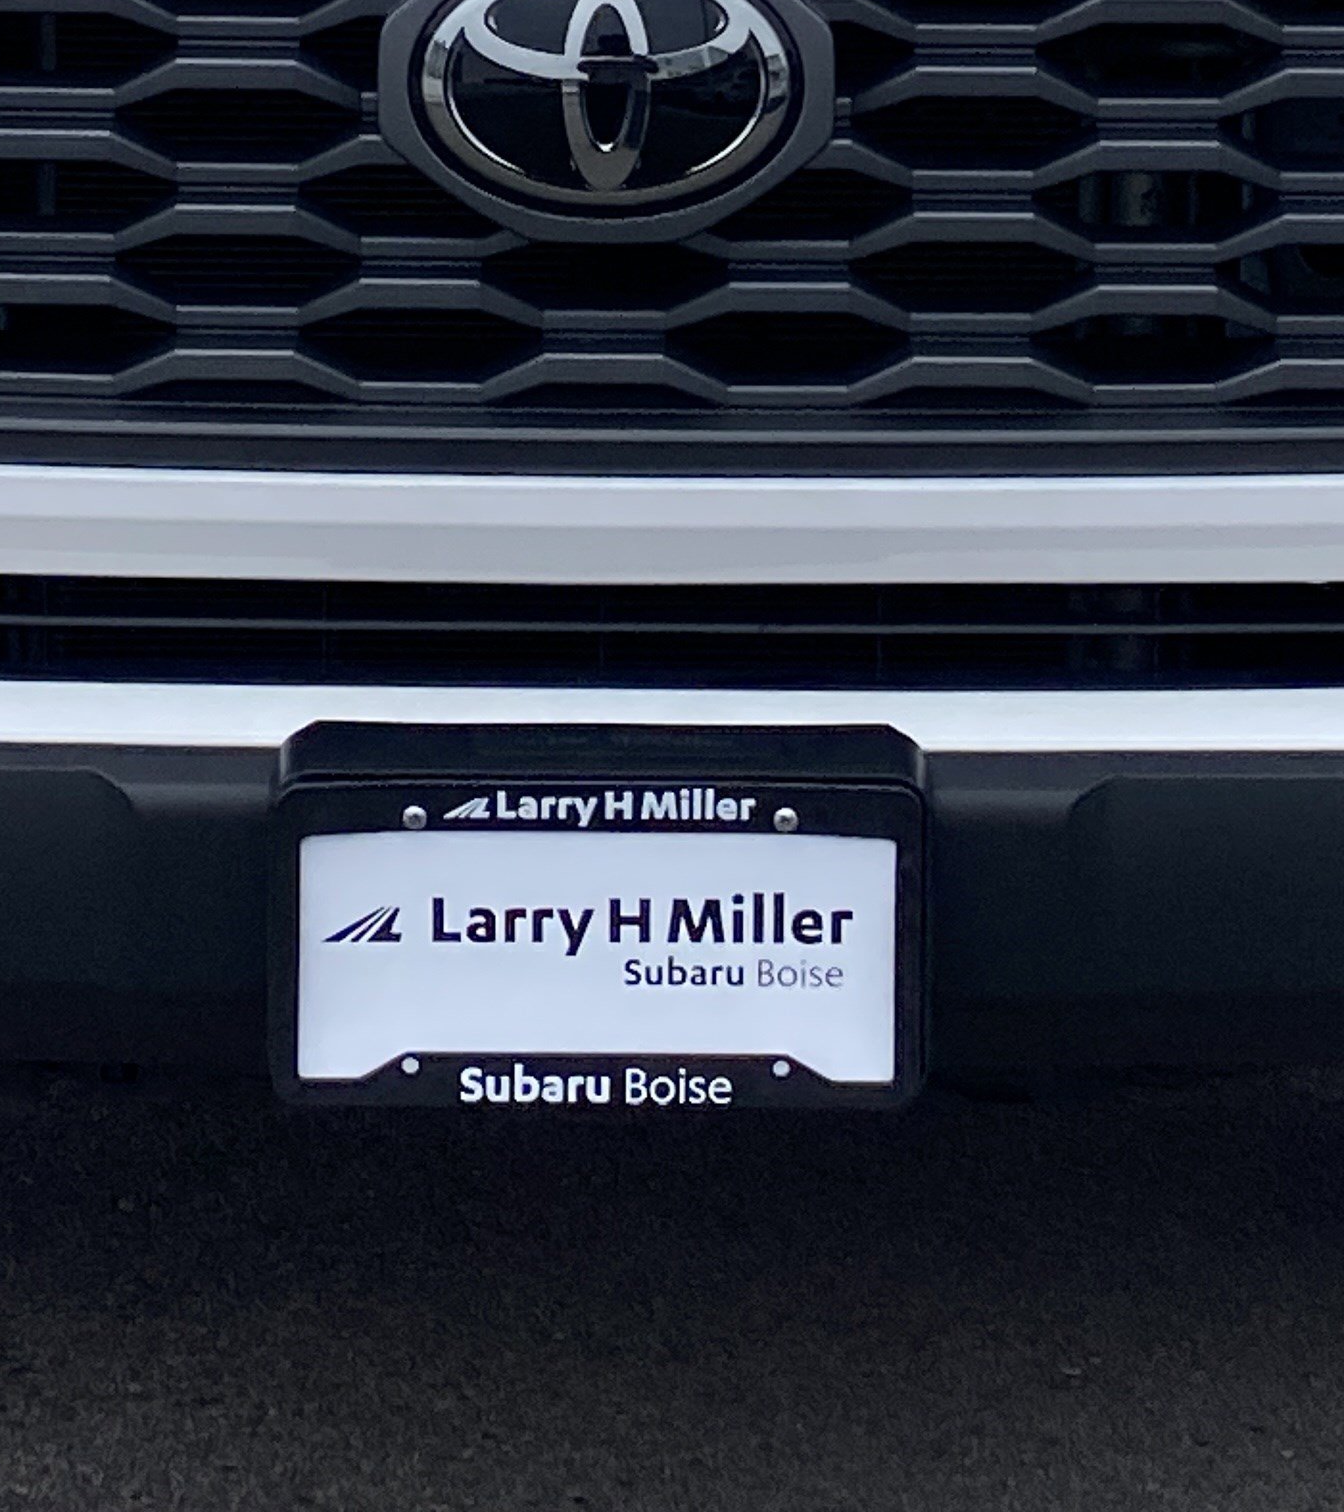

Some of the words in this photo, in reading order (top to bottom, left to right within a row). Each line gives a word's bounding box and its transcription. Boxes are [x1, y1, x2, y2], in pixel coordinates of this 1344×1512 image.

[496, 790, 598, 828] Larry
[604, 791, 634, 821] H
[640, 788, 756, 822] Miller
[430, 896, 595, 958] Larry
[608, 897, 652, 944] H
[666, 892, 854, 946] Miller
[623, 956, 745, 988] Subaru
[756, 958, 845, 989] Boise
[458, 1063, 612, 1106] Subaru
[624, 1067, 733, 1106] Boise
